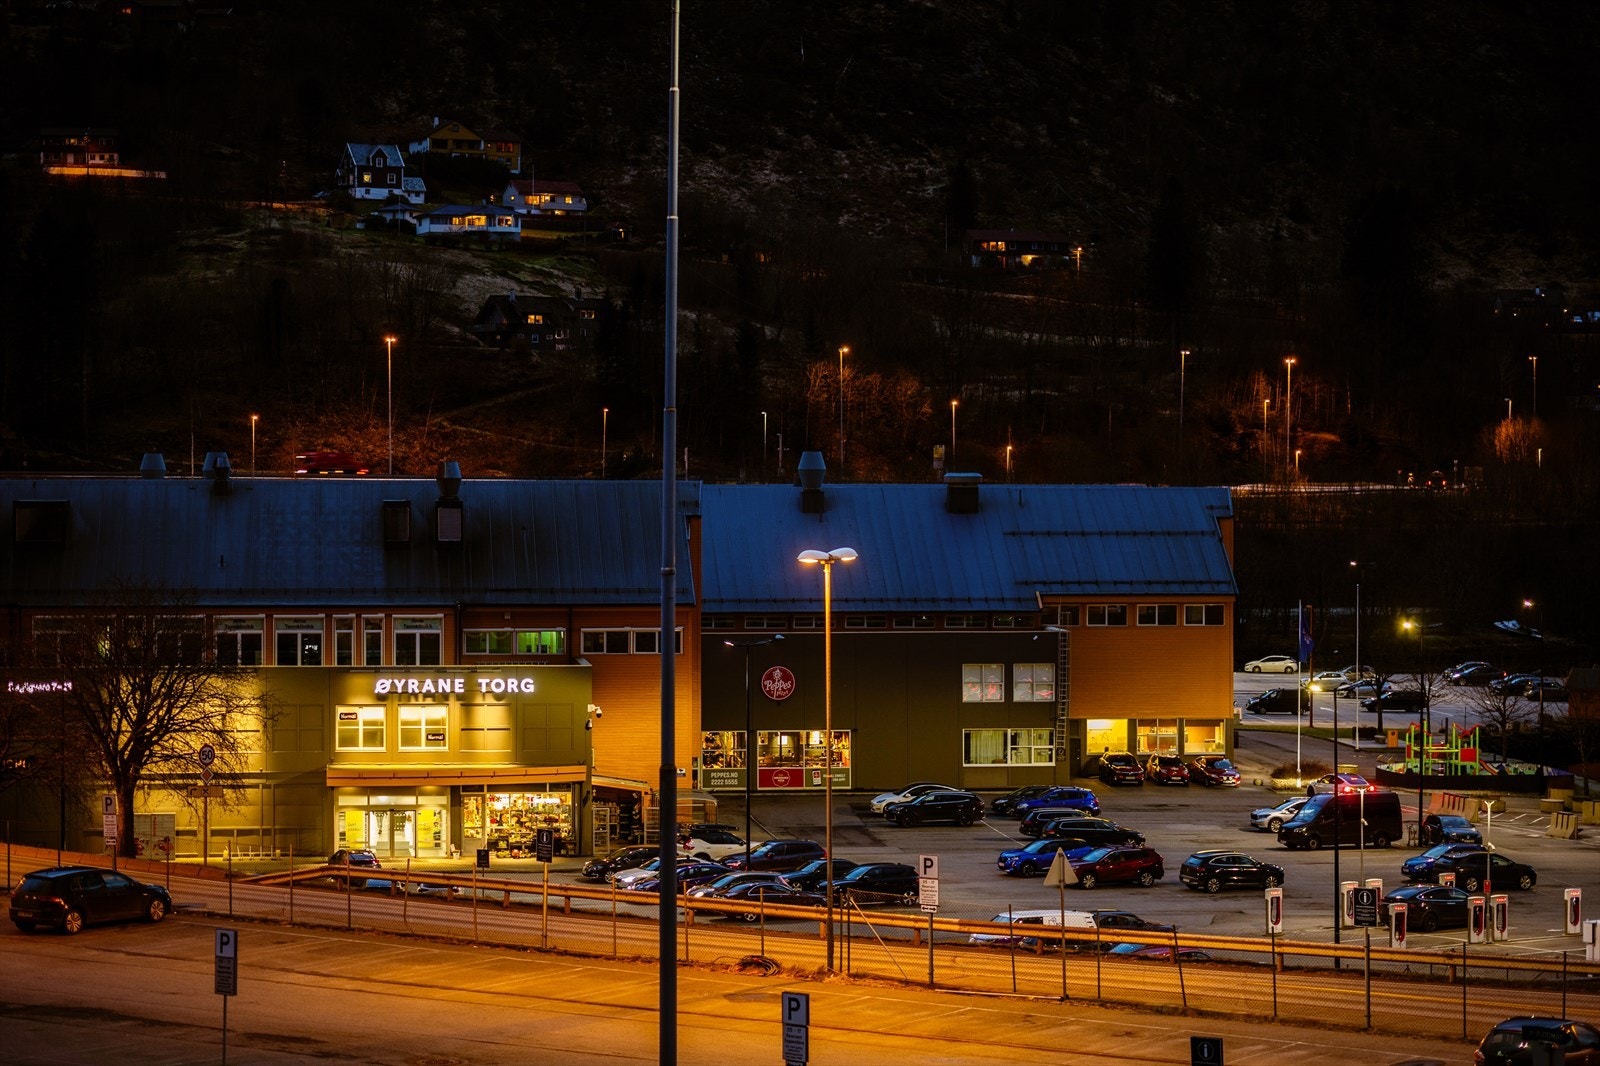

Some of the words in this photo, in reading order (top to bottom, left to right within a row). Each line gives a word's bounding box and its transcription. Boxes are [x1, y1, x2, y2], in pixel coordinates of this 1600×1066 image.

[374, 678, 465, 693] ØYRANE
[478, 678, 535, 693] TORG
[764, 679, 792, 691] Peppes
[202, 750, 213, 760] 50
[105, 797, 113, 812] P
[924, 858, 934, 875] P
[220, 932, 230, 954] P
[788, 997, 801, 1020] P
